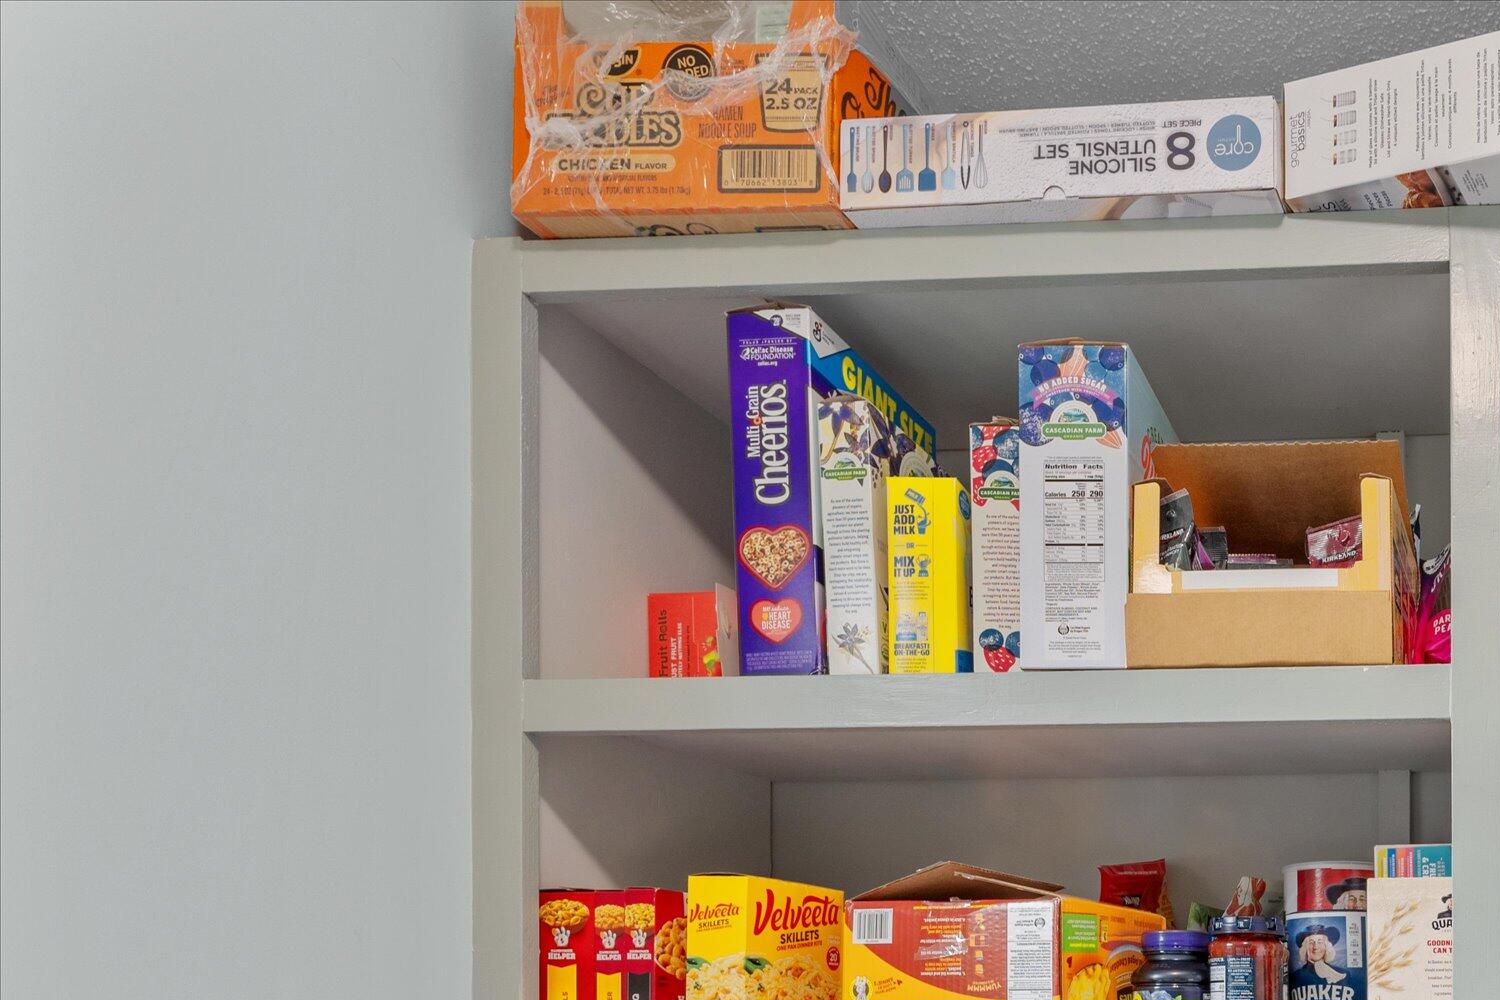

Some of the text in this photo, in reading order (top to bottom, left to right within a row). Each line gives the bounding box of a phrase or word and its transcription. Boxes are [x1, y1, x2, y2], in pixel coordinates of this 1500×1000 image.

[677, 56, 696, 68] NO
[765, 76, 818, 96] 24 PACK
[765, 97, 818, 111] 2.5 OZ
[1296, 111, 1306, 151] basics
[1033, 137, 1156, 160] UTENSIL SET
[1166, 131, 1196, 171] 8
[558, 157, 667, 172] CHICKEN FLAVOR
[1069, 156, 1156, 176] SILICONE
[1039, 377, 1107, 394] NO ADDED SUGAR
[841, 354, 935, 456] GIANT SIZE
[745, 384, 761, 458] Multi Grain
[1045, 426, 1103, 435] CASCADIAN FARM
[754, 383, 791, 506] Cheerios
[1044, 463, 1078, 471] Nutrition
[1071, 490, 1085, 498] 250
[1089, 490, 1104, 498] 290
[894, 504, 915, 515] JUST
[894, 514, 915, 525] ADD
[894, 524, 915, 535] MILK
[894, 556, 914, 567] MIX
[768, 611, 791, 621] HEART
[761, 620, 791, 630] DISEASE
[690, 902, 740, 922] Velveeta
[754, 888, 839, 936] Velveeta
[698, 919, 730, 929] SKILLETS
[780, 930, 820, 944] SKILLETS
[548, 952, 576, 960] HELPER
[596, 953, 621, 961] HELPER
[627, 952, 651, 960] HELPER
